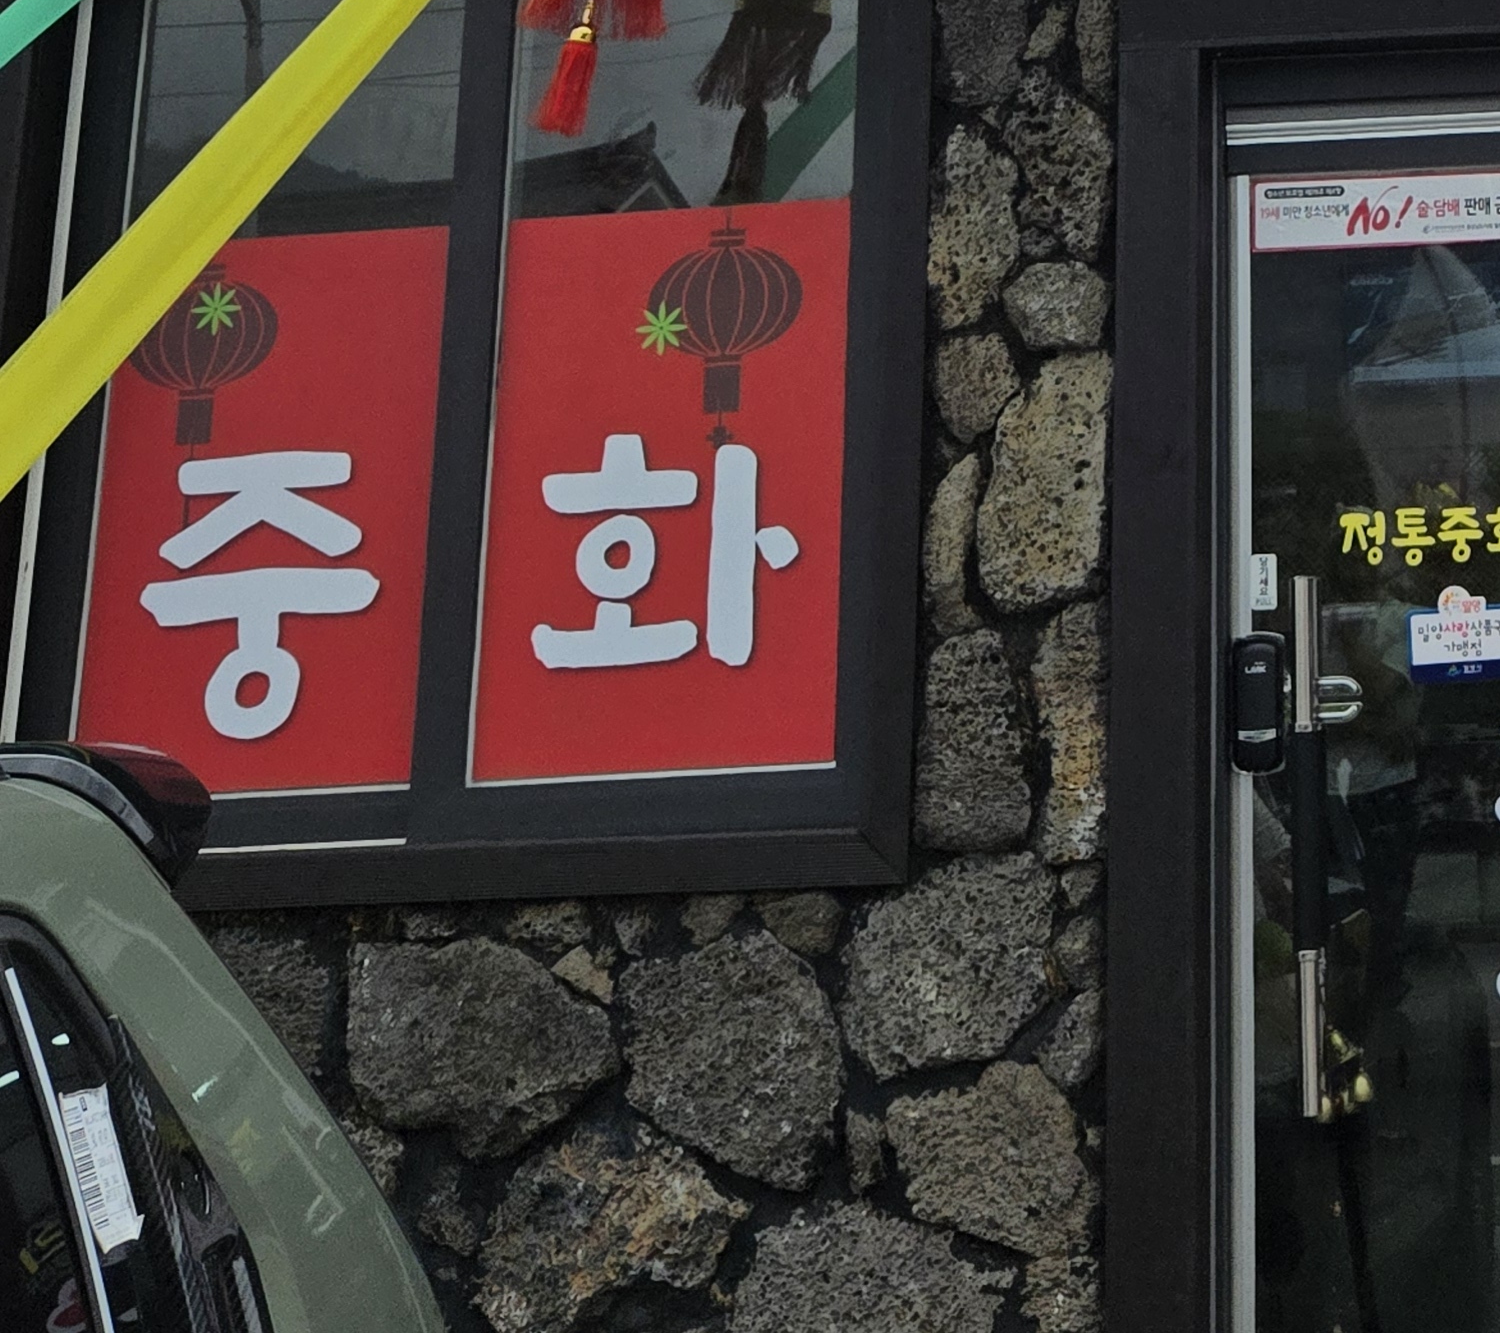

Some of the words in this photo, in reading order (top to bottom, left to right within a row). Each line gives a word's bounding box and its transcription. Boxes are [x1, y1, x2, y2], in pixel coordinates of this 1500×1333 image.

[1283, 204, 1302, 220] 미만
[1463, 196, 1491, 216] 판매
[140, 434, 799, 740] 중화
[1259, 556, 1269, 596] 당기세요
[1443, 639, 1483, 658] 가맹점
